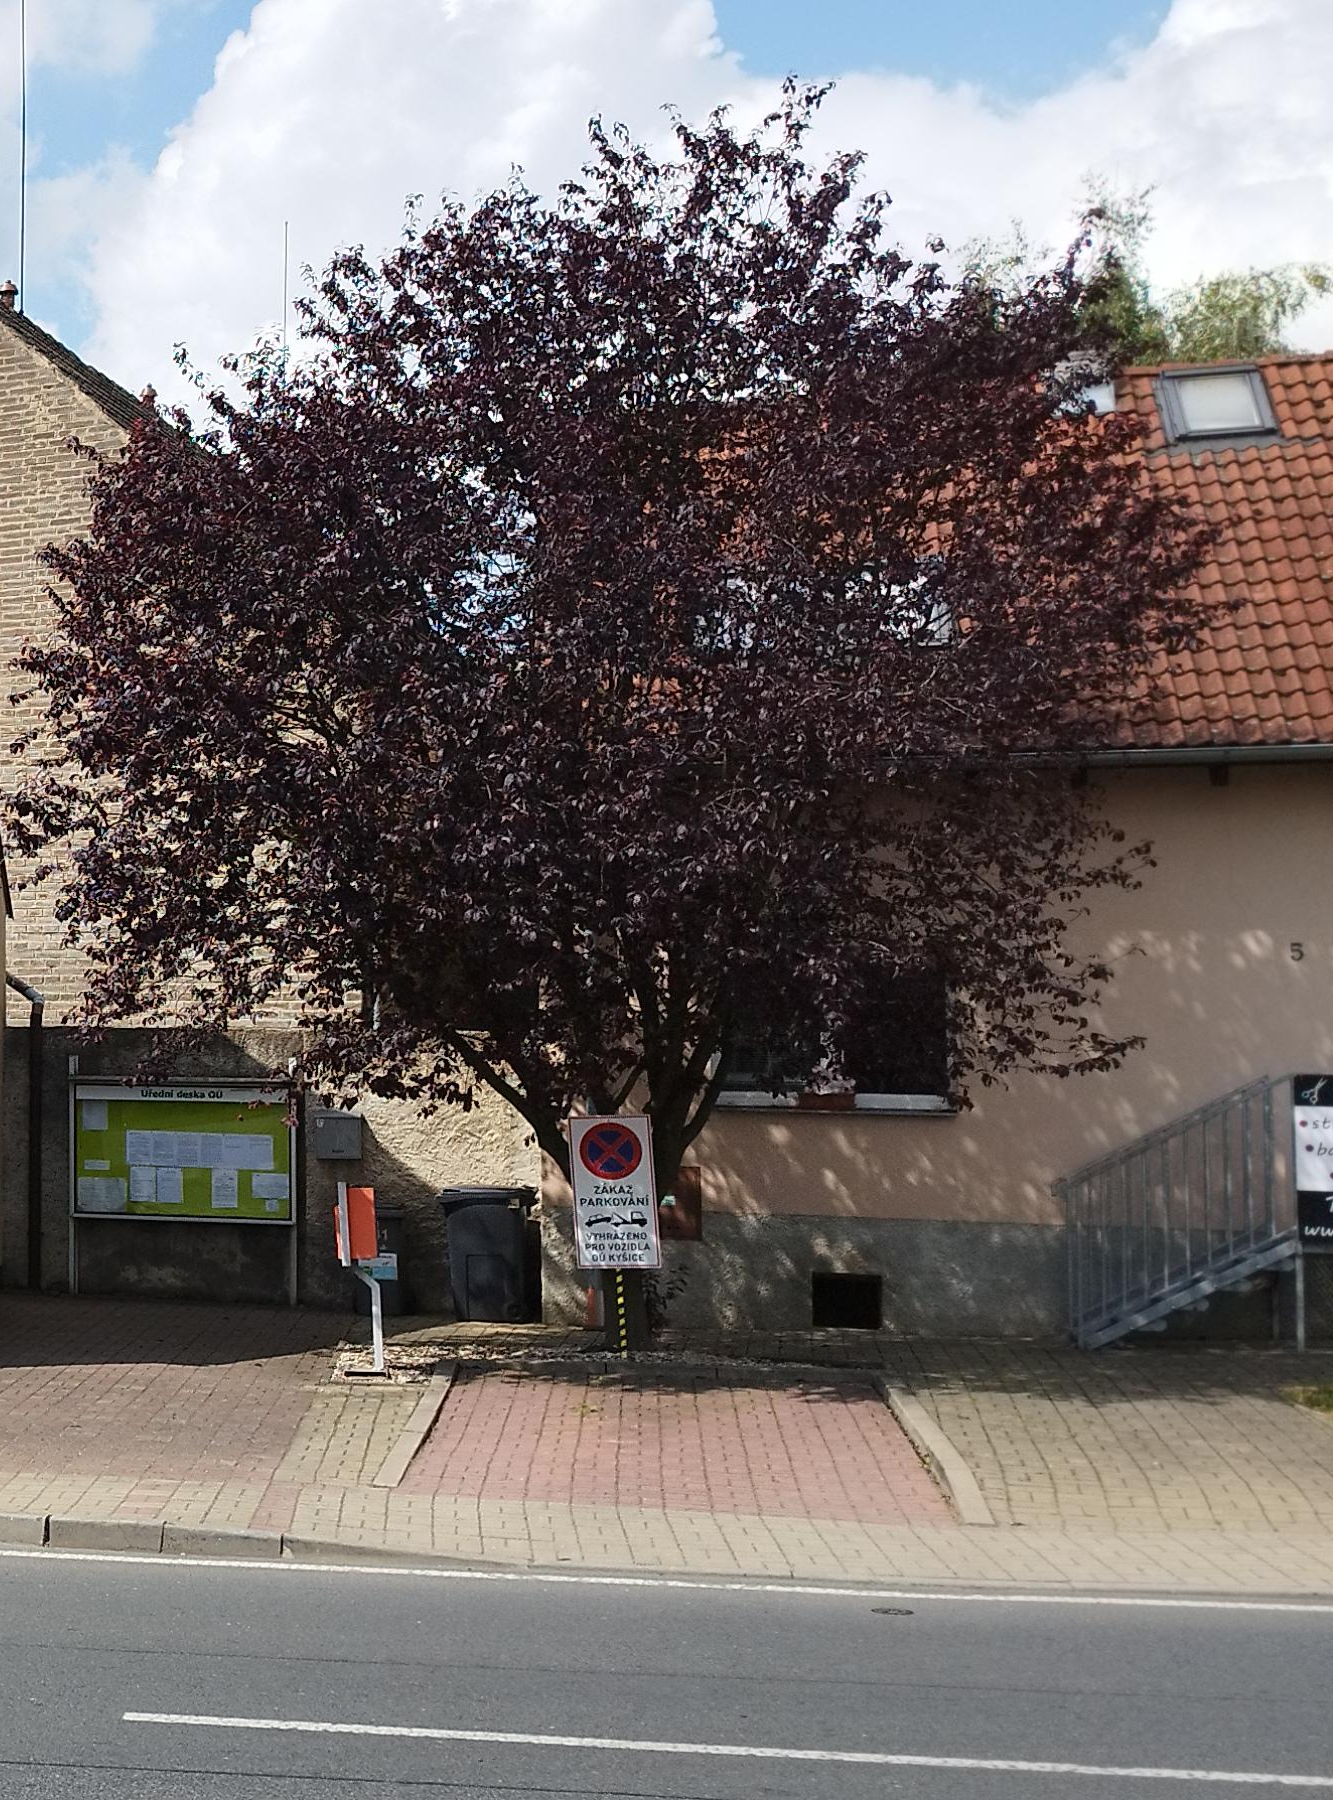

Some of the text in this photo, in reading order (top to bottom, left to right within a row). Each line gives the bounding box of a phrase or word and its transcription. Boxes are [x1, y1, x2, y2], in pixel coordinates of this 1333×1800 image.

[1290, 943, 1303, 961] 5
[176, 1089, 206, 1099] deska
[593, 1182, 633, 1194] ZÁKAZ
[579, 1193, 649, 1207] PARKOVÁNÍ
[585, 1242, 650, 1251] PRO VOZIDLA
